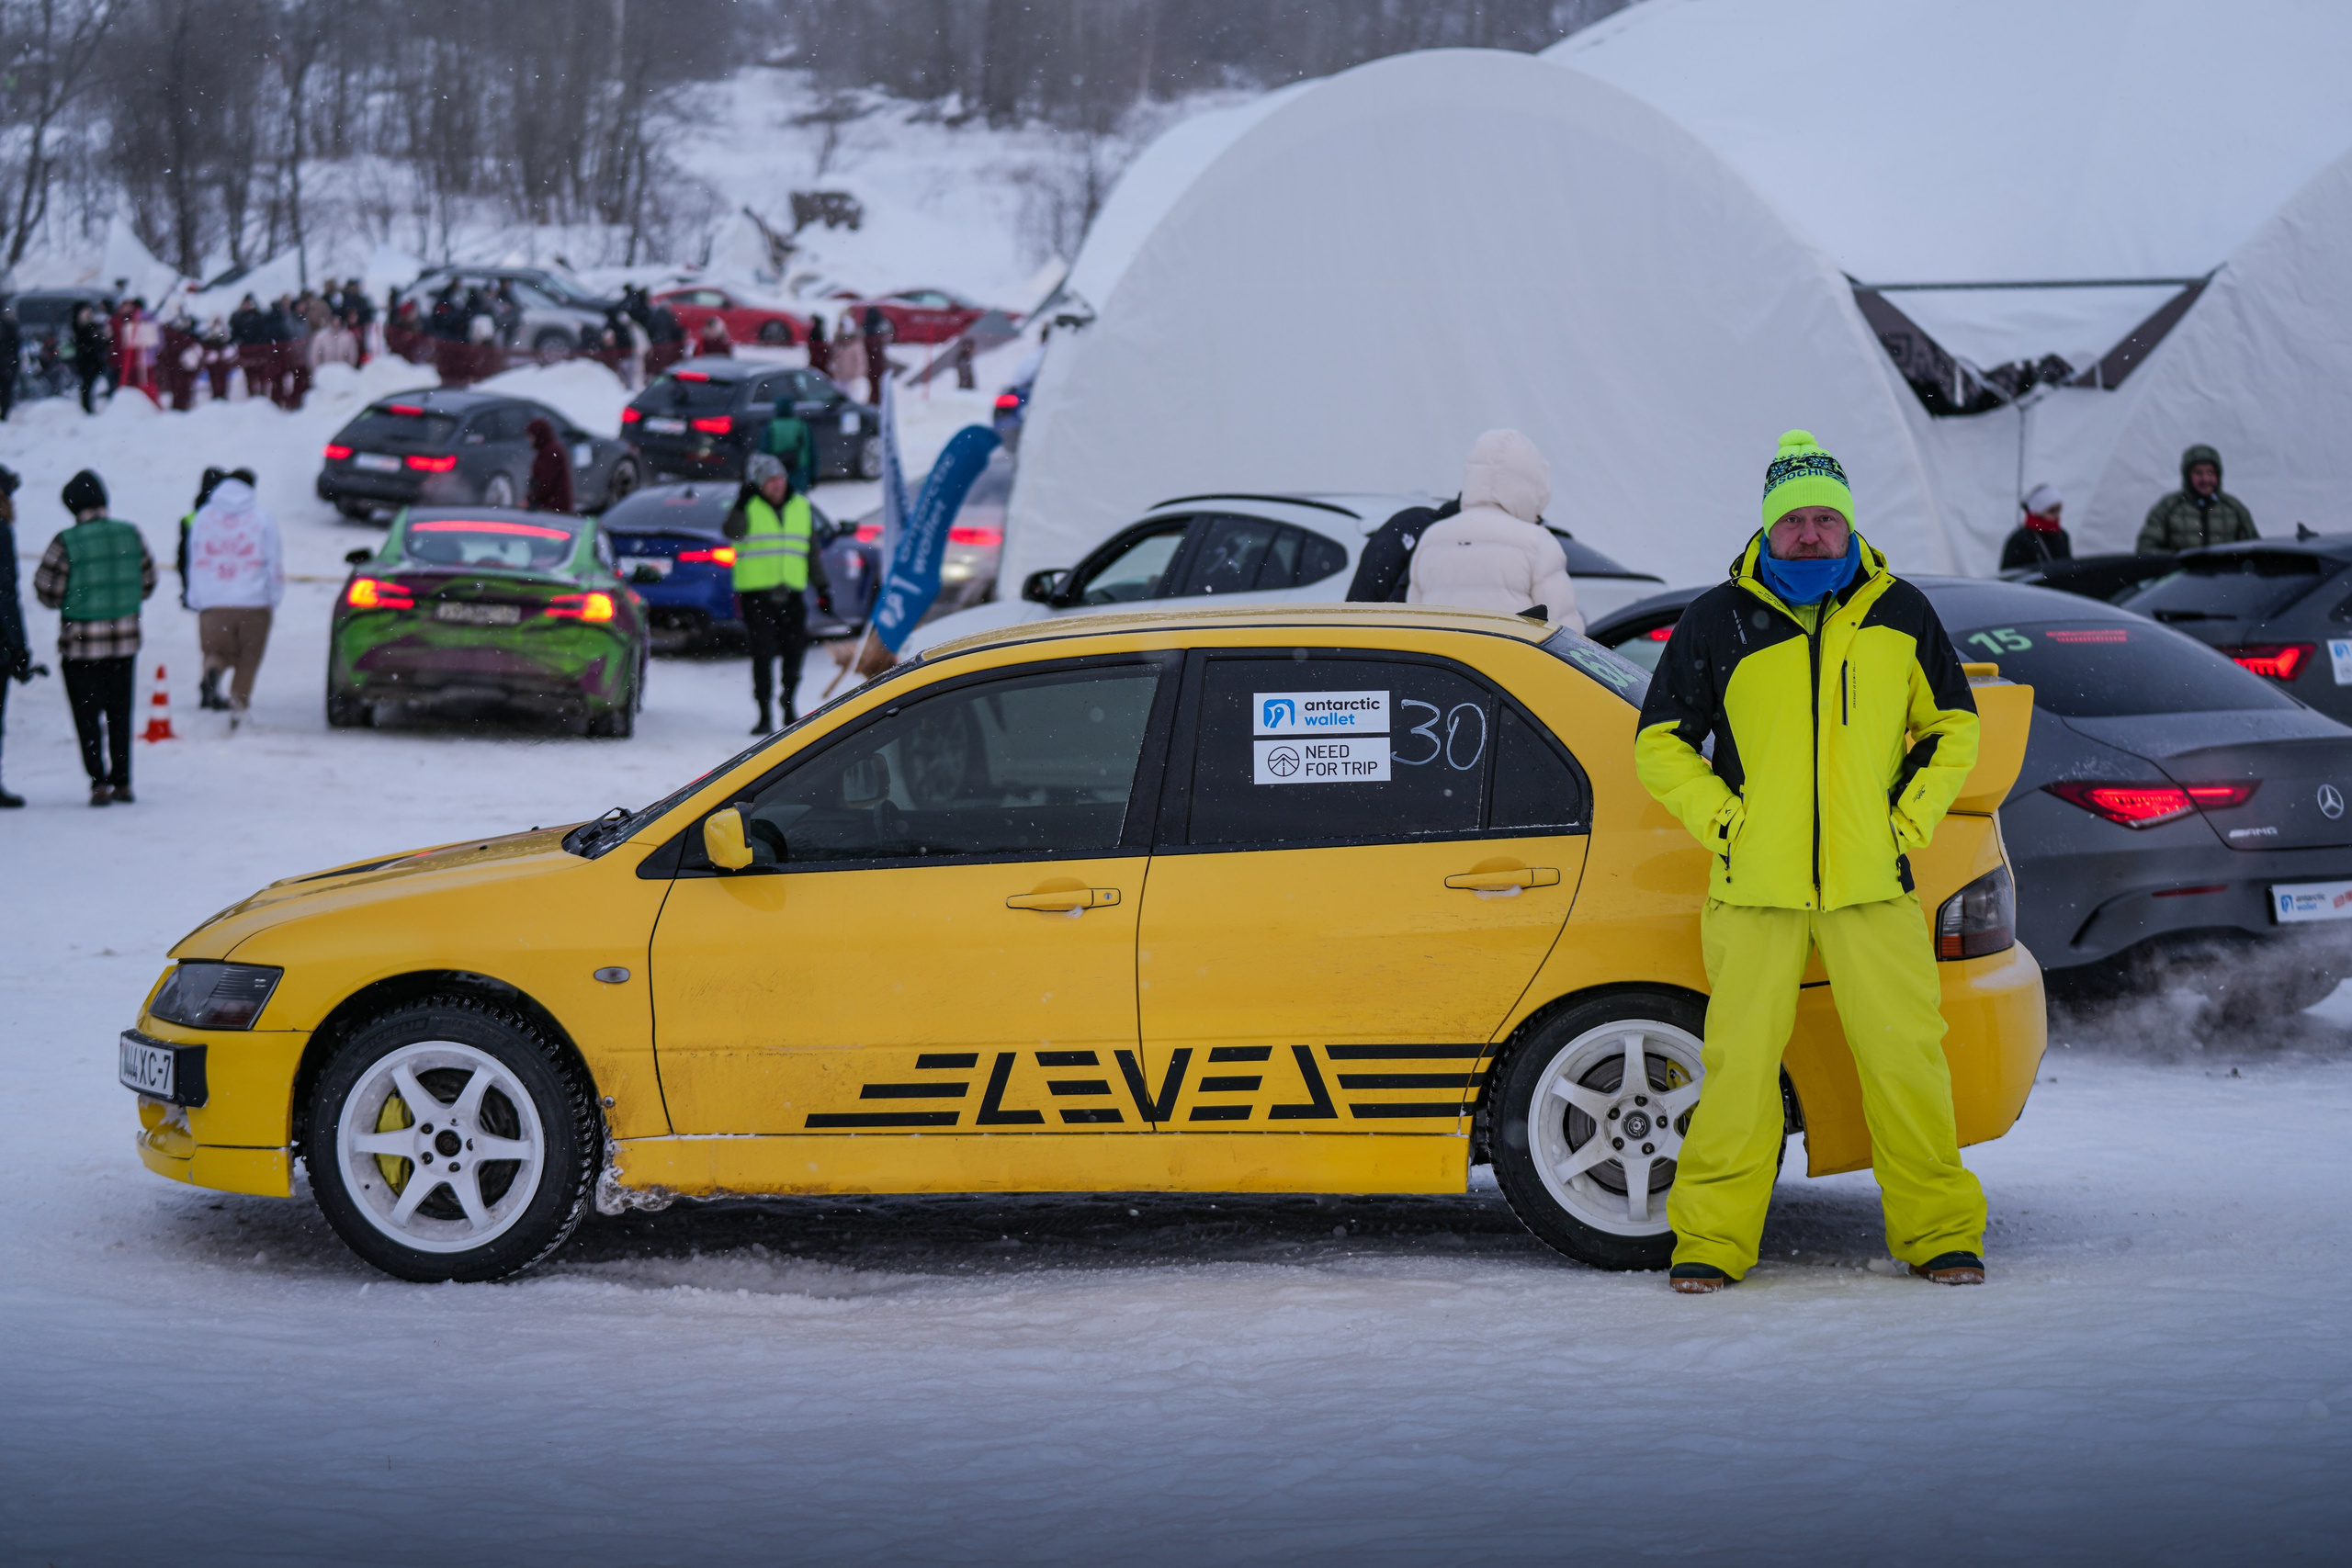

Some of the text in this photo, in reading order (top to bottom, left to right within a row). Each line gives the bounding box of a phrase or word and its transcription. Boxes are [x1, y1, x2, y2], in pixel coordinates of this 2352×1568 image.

[1778, 468, 1823, 485] SOCHI
[1967, 627, 2033, 656] 15
[1304, 697, 1381, 712] antarctic
[1304, 712, 1356, 727] wallet
[1390, 698, 1487, 771] 30
[1305, 744, 1351, 760] NEED
[1306, 761, 1378, 777] FOR TRIP
